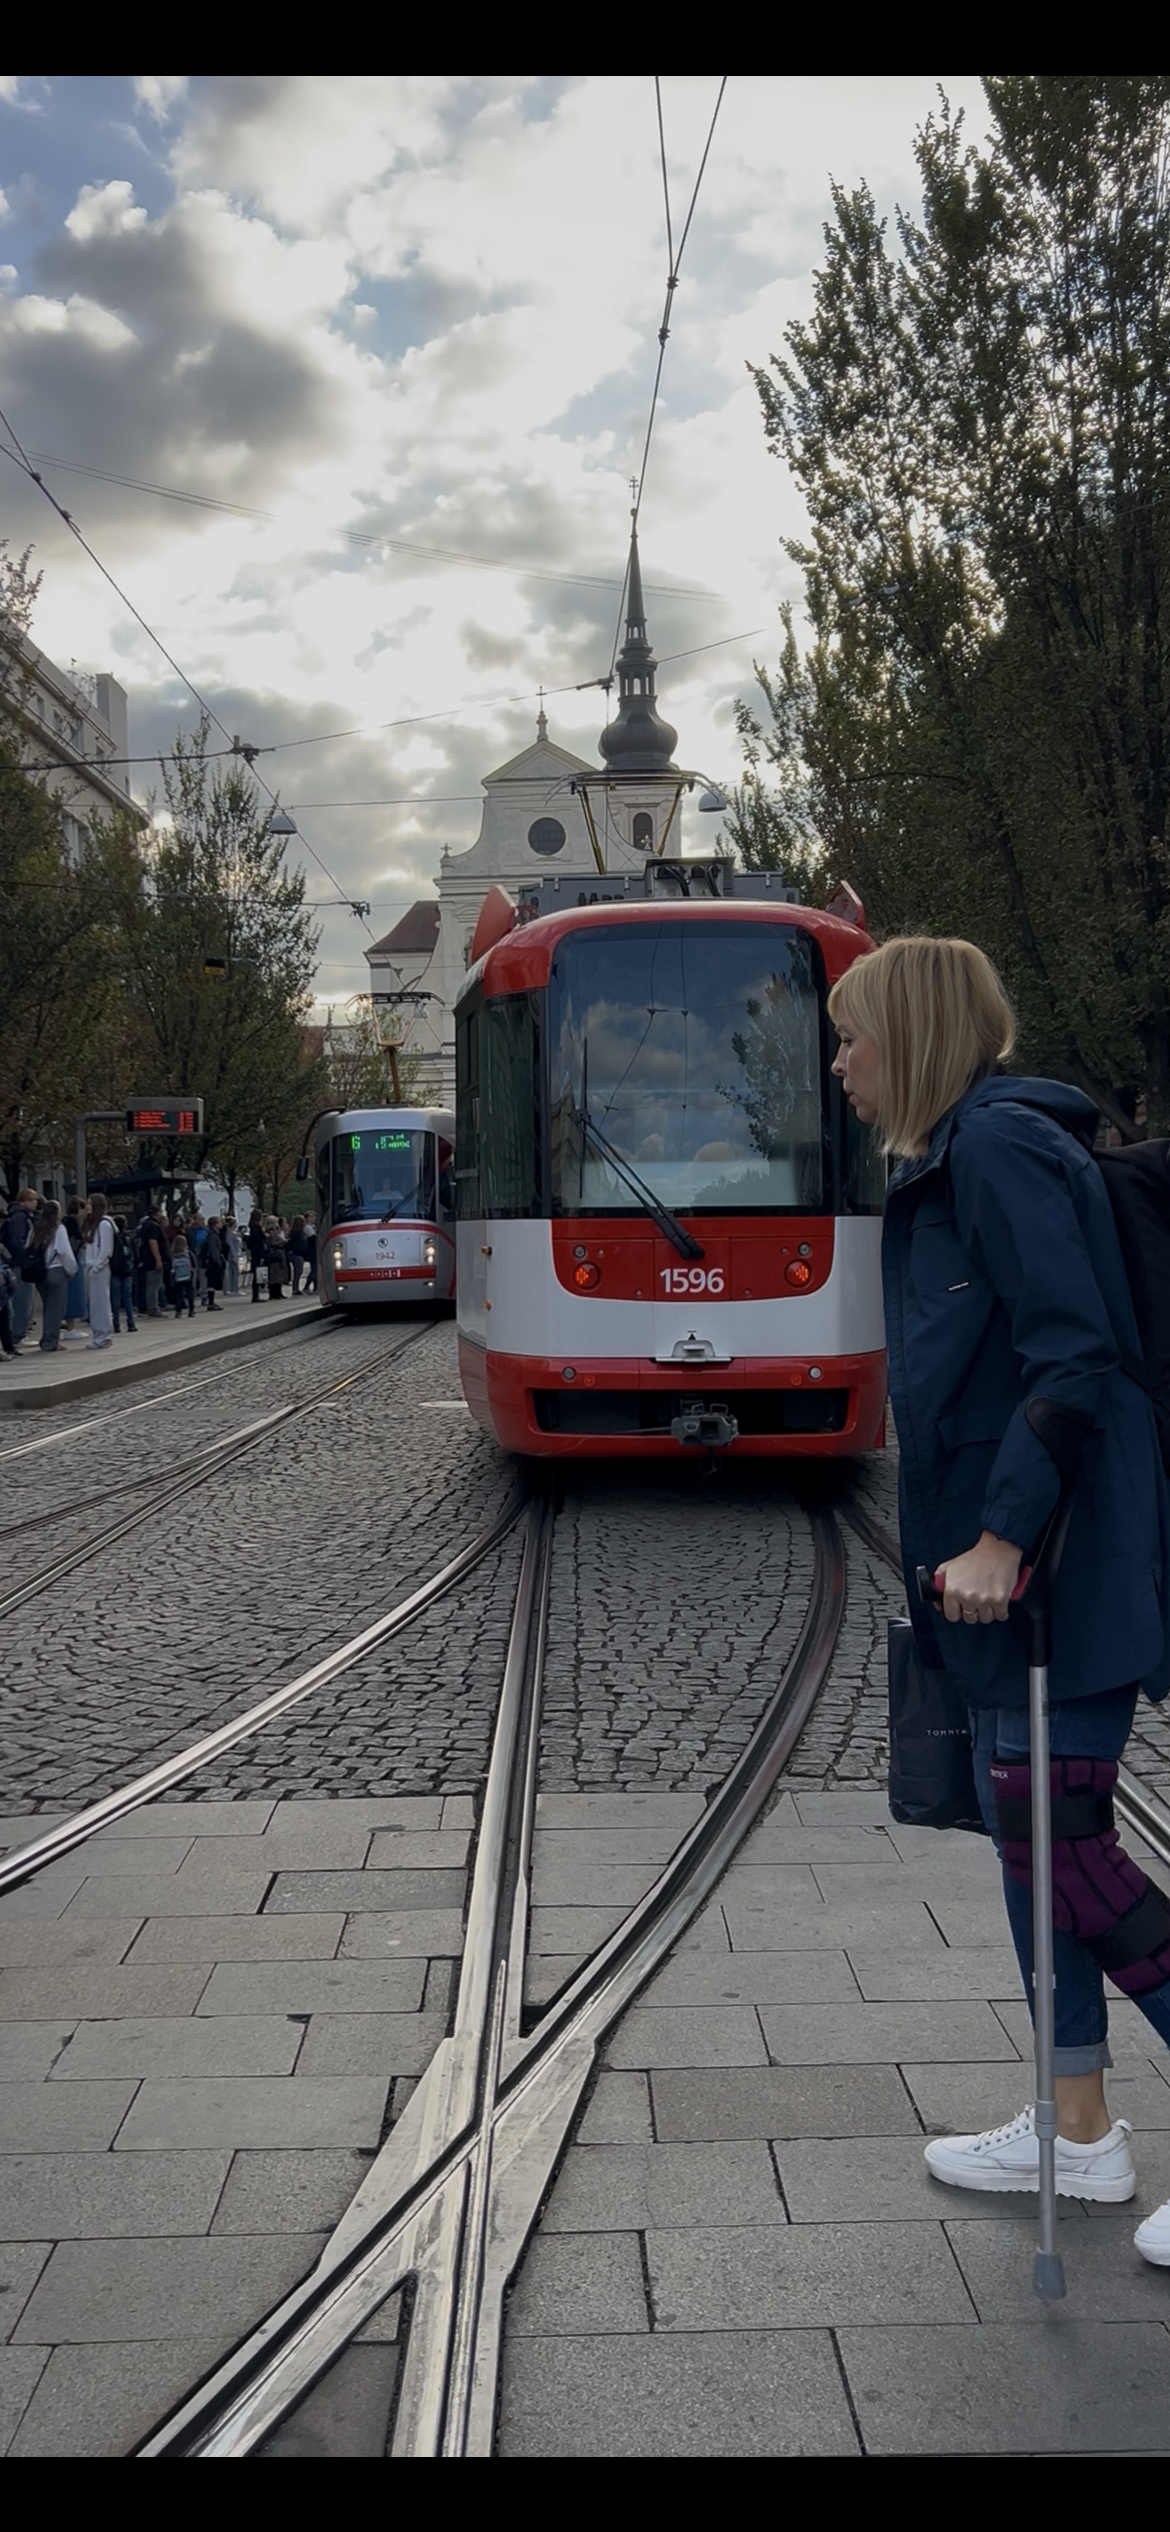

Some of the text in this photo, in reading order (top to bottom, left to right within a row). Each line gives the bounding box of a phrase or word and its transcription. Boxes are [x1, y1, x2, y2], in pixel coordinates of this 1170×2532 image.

[375, 1251, 396, 1260] 1942
[660, 1267, 725, 1293] 1596
[926, 1729, 960, 1737] TOMMY
